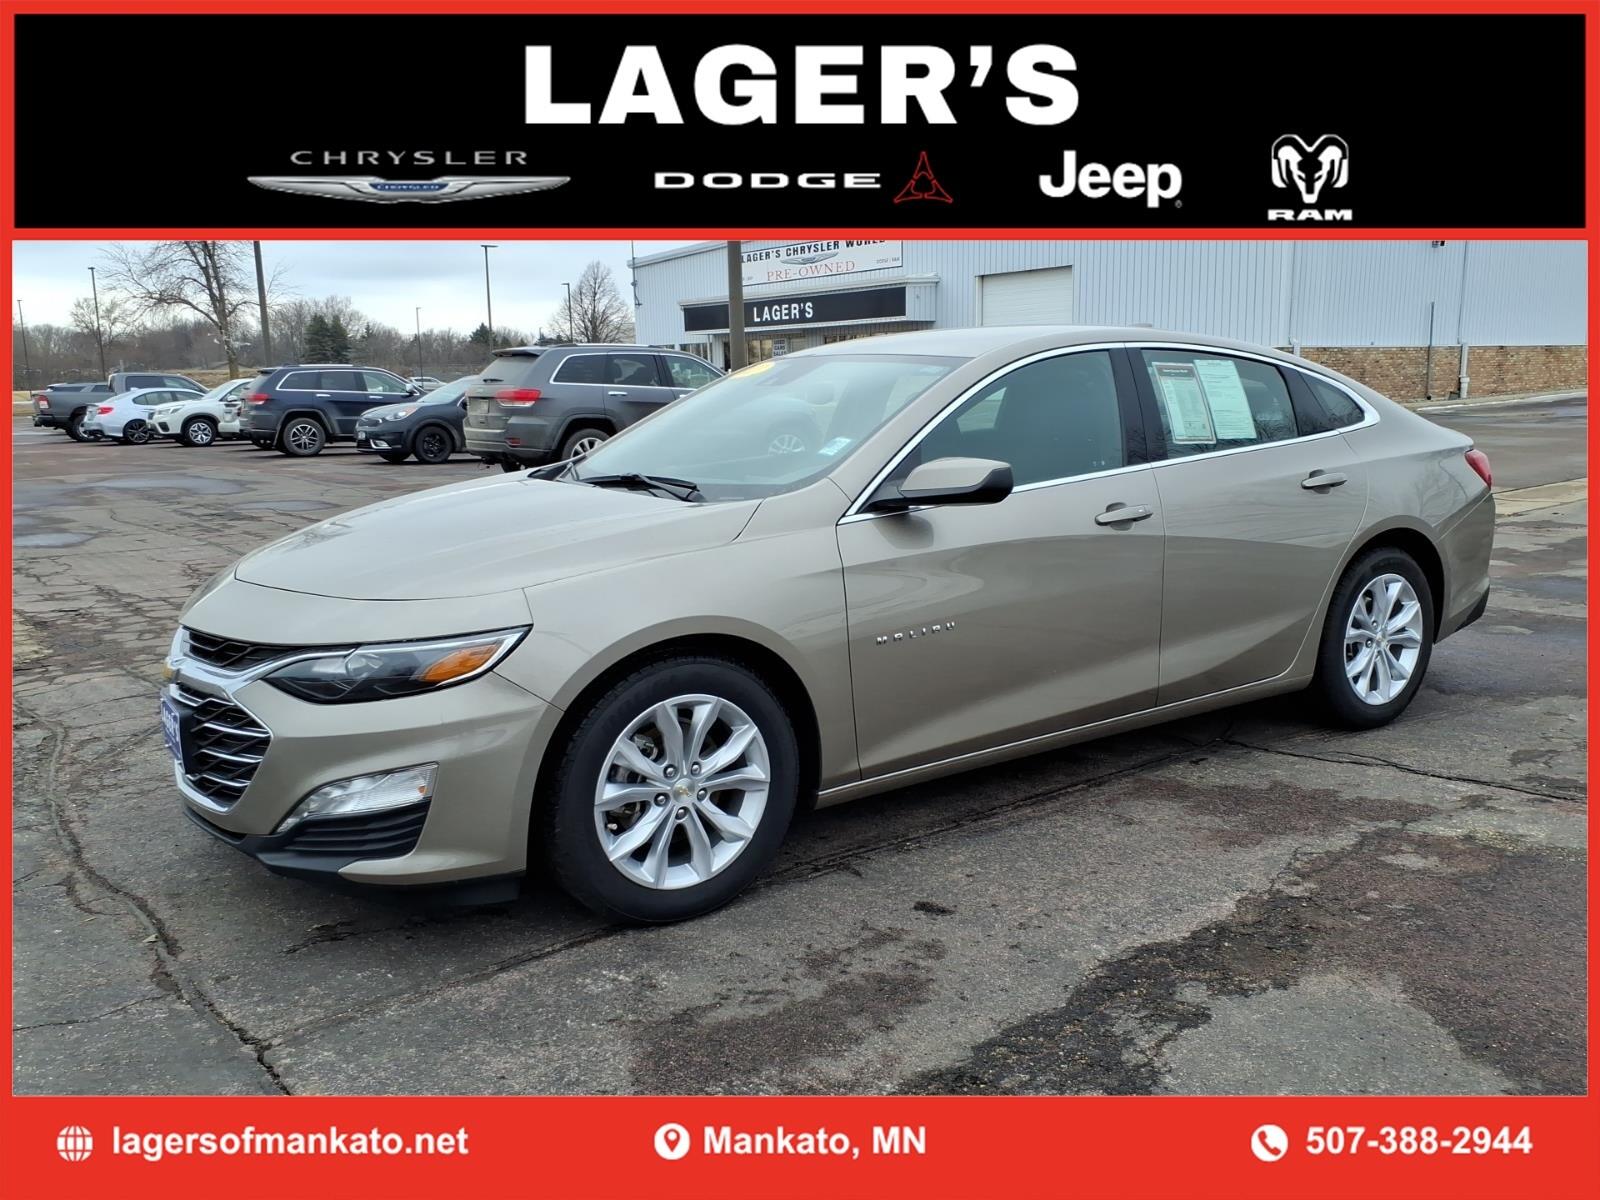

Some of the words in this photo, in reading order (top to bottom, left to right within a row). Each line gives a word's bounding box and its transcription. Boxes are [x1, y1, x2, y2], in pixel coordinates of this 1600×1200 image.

[786, 240, 840, 257] CHRYSLER
[768, 261, 855, 281] PRE-OWNED
[754, 302, 813, 322] LAGER'S
[877, 622, 955, 643] MALIBU
